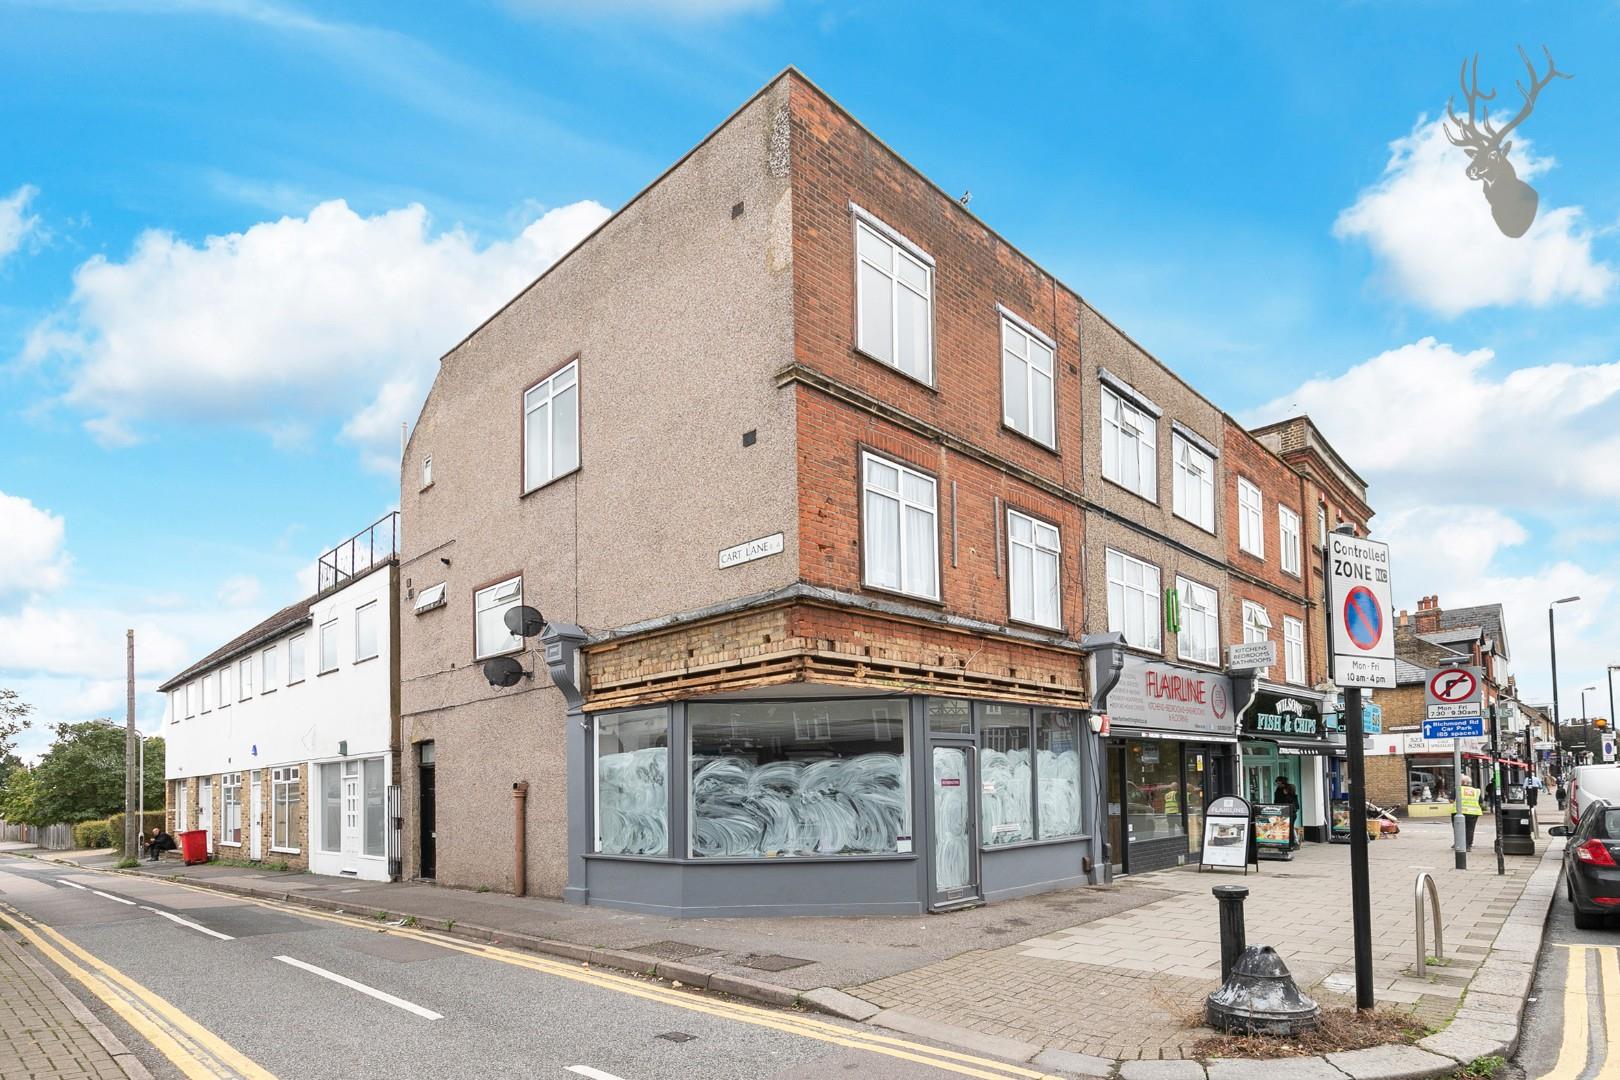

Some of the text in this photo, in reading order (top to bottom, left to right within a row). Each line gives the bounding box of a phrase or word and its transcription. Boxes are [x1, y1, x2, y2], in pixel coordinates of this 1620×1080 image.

[720, 550, 743, 564] CART
[745, 541, 769, 557] LANE
[1334, 540, 1386, 563] Controlled
[1334, 559, 1372, 581] ZONE
[1233, 651, 1270, 660] BEDROOMS
[1234, 645, 1268, 653] KITCHENS
[1231, 657, 1272, 666] BATHROOMS
[1145, 670, 1206, 705] FLAIRLINE
[1257, 713, 1316, 734] FISH & CHIPS
